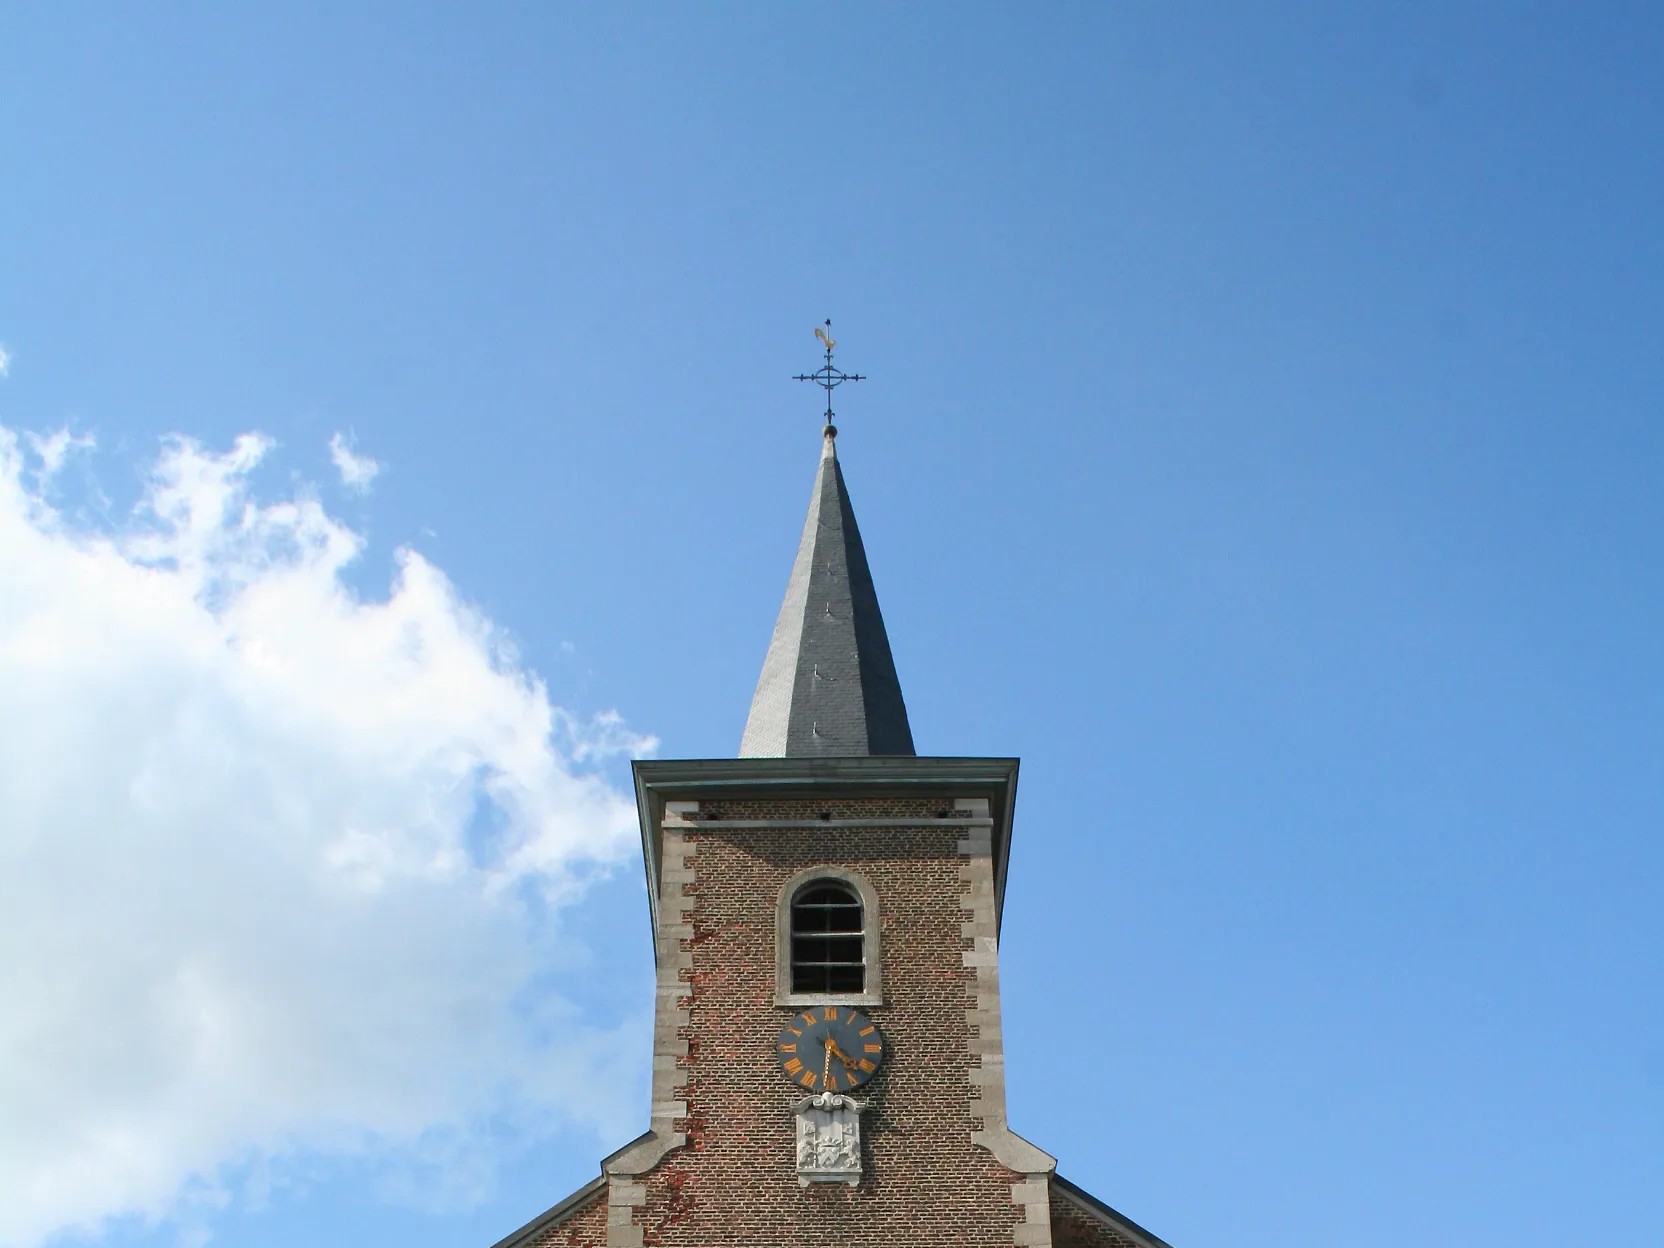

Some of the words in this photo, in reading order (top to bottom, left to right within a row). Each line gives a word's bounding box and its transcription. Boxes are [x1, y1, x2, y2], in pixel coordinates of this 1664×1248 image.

[802, 1011, 816, 1027] XI
[824, 1007, 837, 1020] XII
[847, 1011, 857, 1024] I
[787, 1026, 802, 1037] X
[859, 1026, 875, 1037] II
[781, 1043, 796, 1053] IX
[864, 1044, 881, 1053] III
[784, 1057, 803, 1076] VIII
[800, 1070, 817, 1088] VII
[847, 1072, 858, 1086] V
